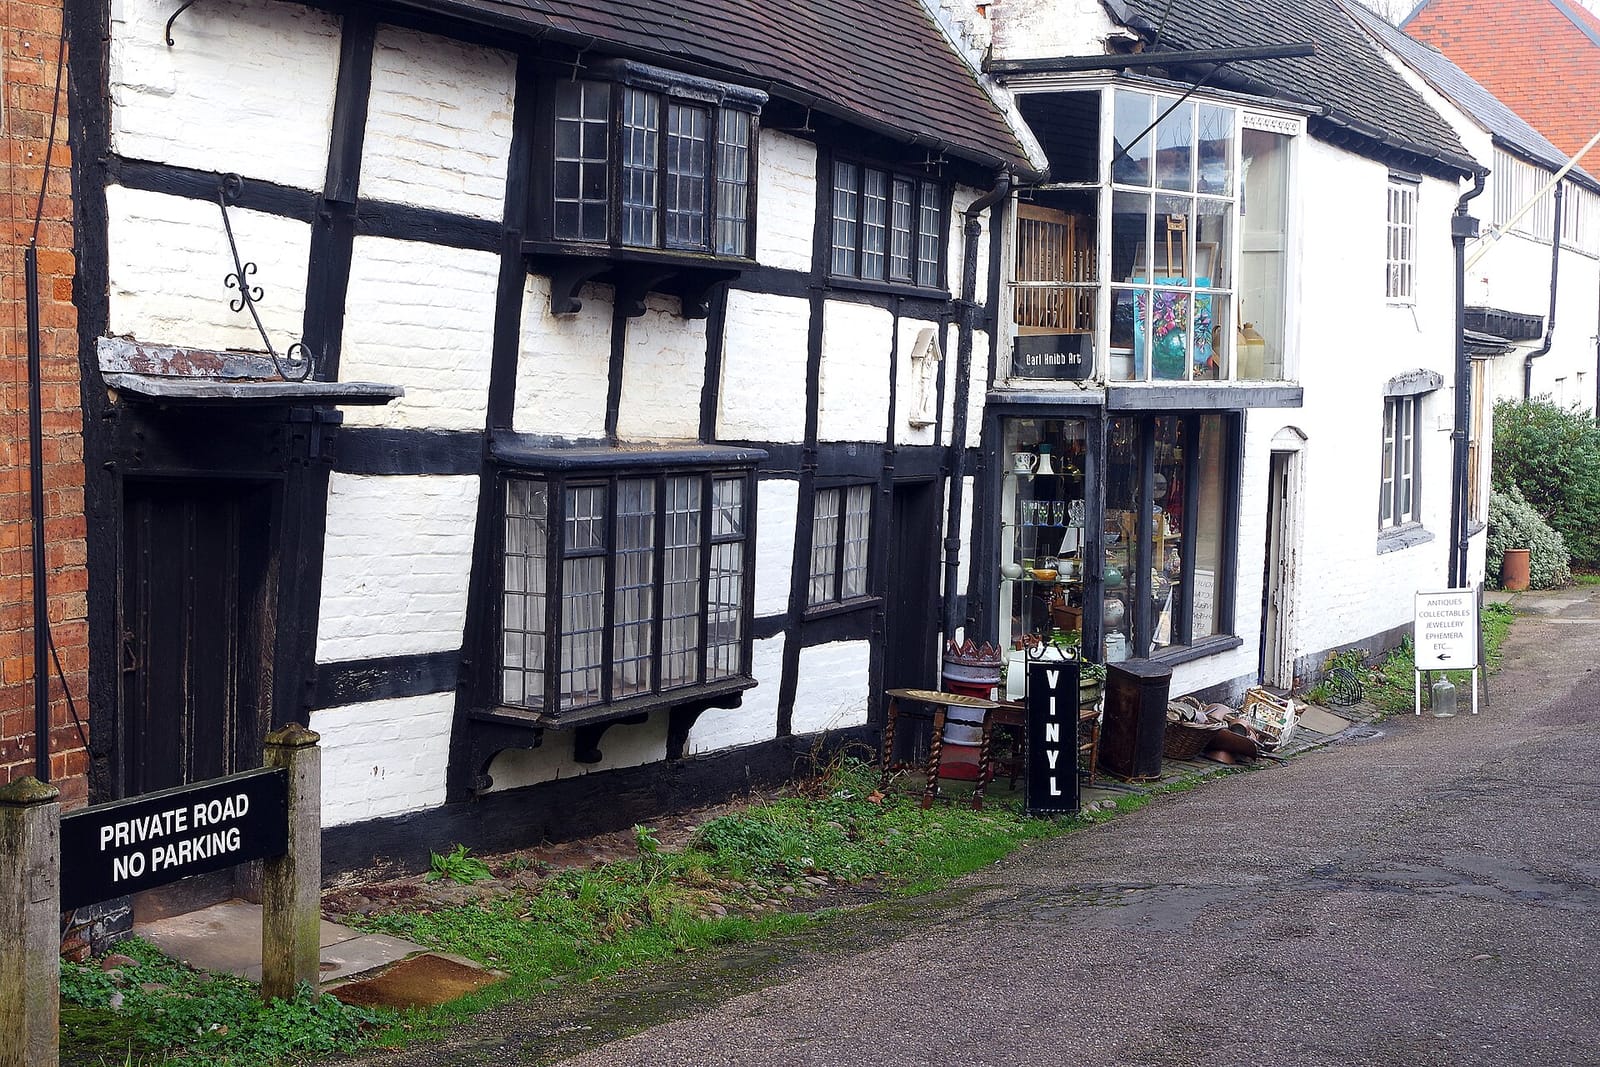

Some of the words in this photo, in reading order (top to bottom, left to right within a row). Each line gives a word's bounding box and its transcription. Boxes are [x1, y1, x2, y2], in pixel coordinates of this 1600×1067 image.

[1026, 353, 1042, 366] Carl
[1044, 352, 1066, 366] Knibb
[1068, 352, 1082, 365] Art
[1427, 598, 1462, 606] ANTIQUES
[1418, 609, 1470, 618] COLLECTABLES
[1426, 621, 1464, 629] JEWELLERY
[1425, 632, 1464, 640] EPHEMERA
[1045, 669, 1062, 796] VINYL
[100, 807, 188, 851] PRIVATE
[193, 793, 249, 828] ROAD
[113, 851, 146, 882] NO
[152, 827, 241, 872] PARKING
